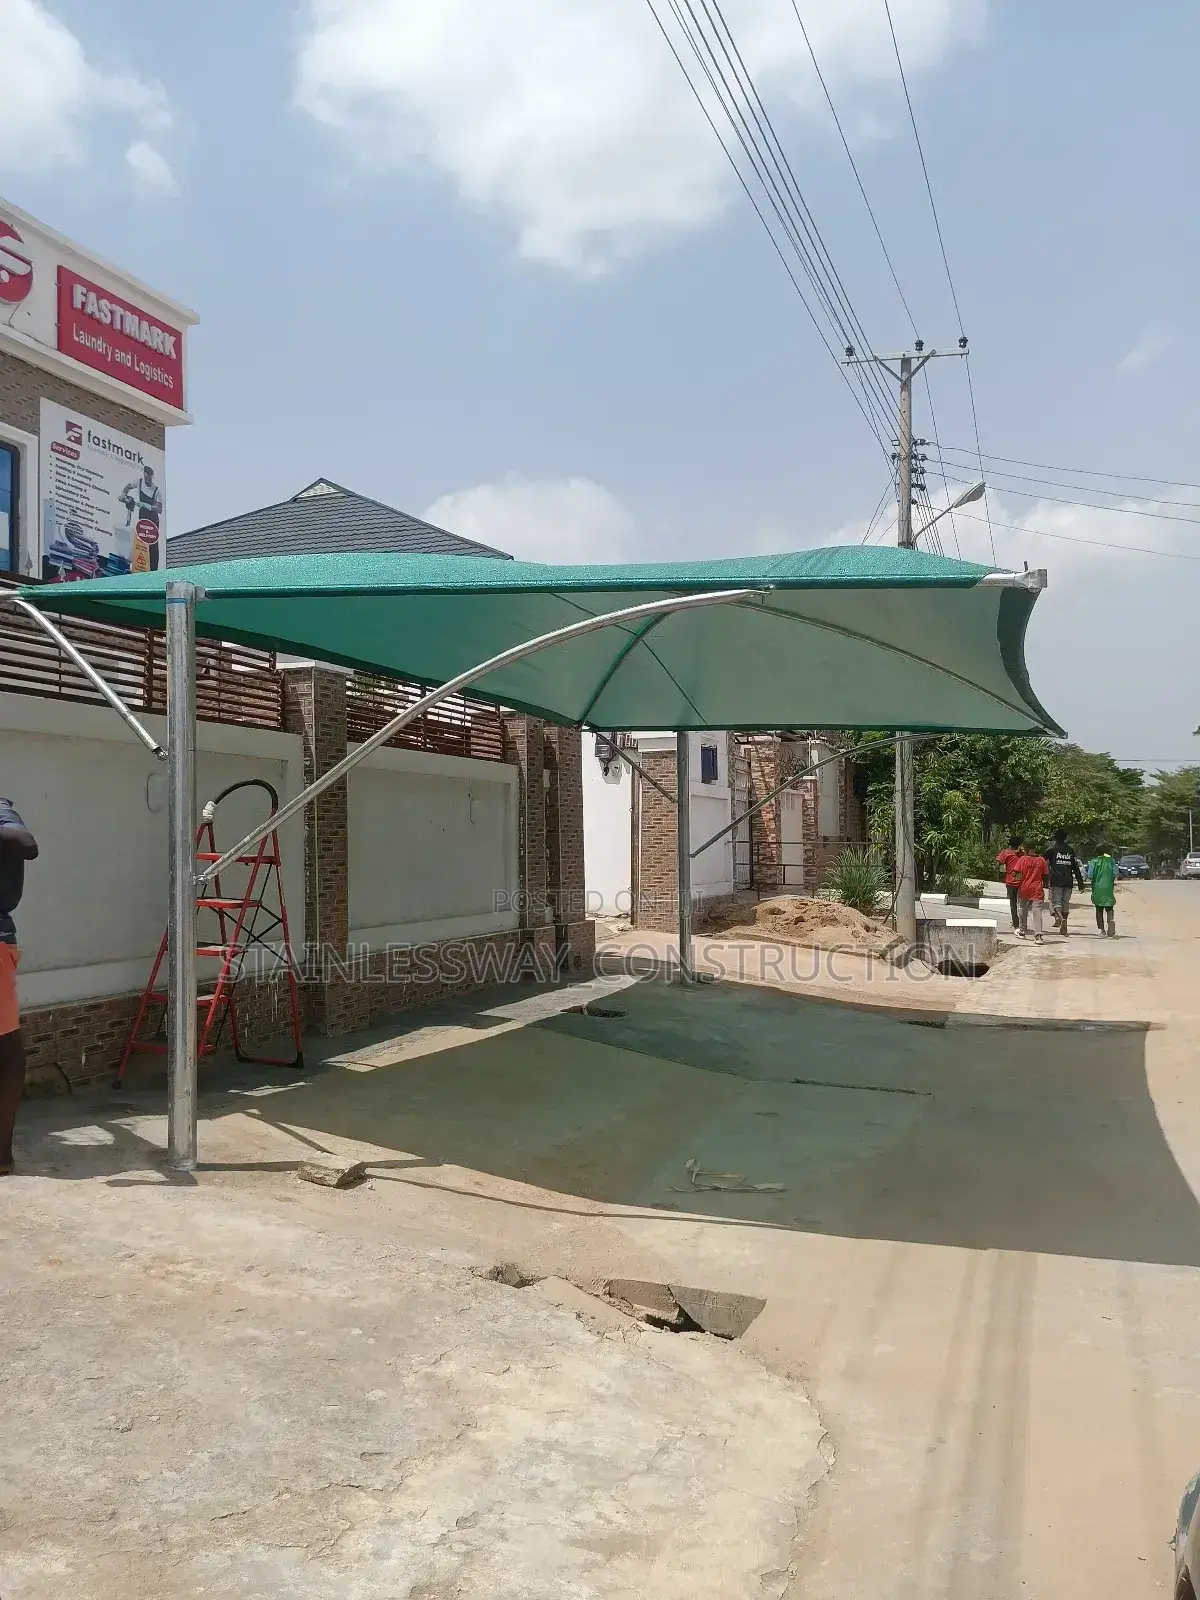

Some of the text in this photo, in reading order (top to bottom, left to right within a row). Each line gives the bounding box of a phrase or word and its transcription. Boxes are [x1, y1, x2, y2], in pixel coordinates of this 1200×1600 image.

[72, 283, 177, 360] FASTMARK
[73, 322, 174, 389] Laundry and Logistics
[51, 442, 78, 458] Services
[87, 429, 145, 466] fastmark
